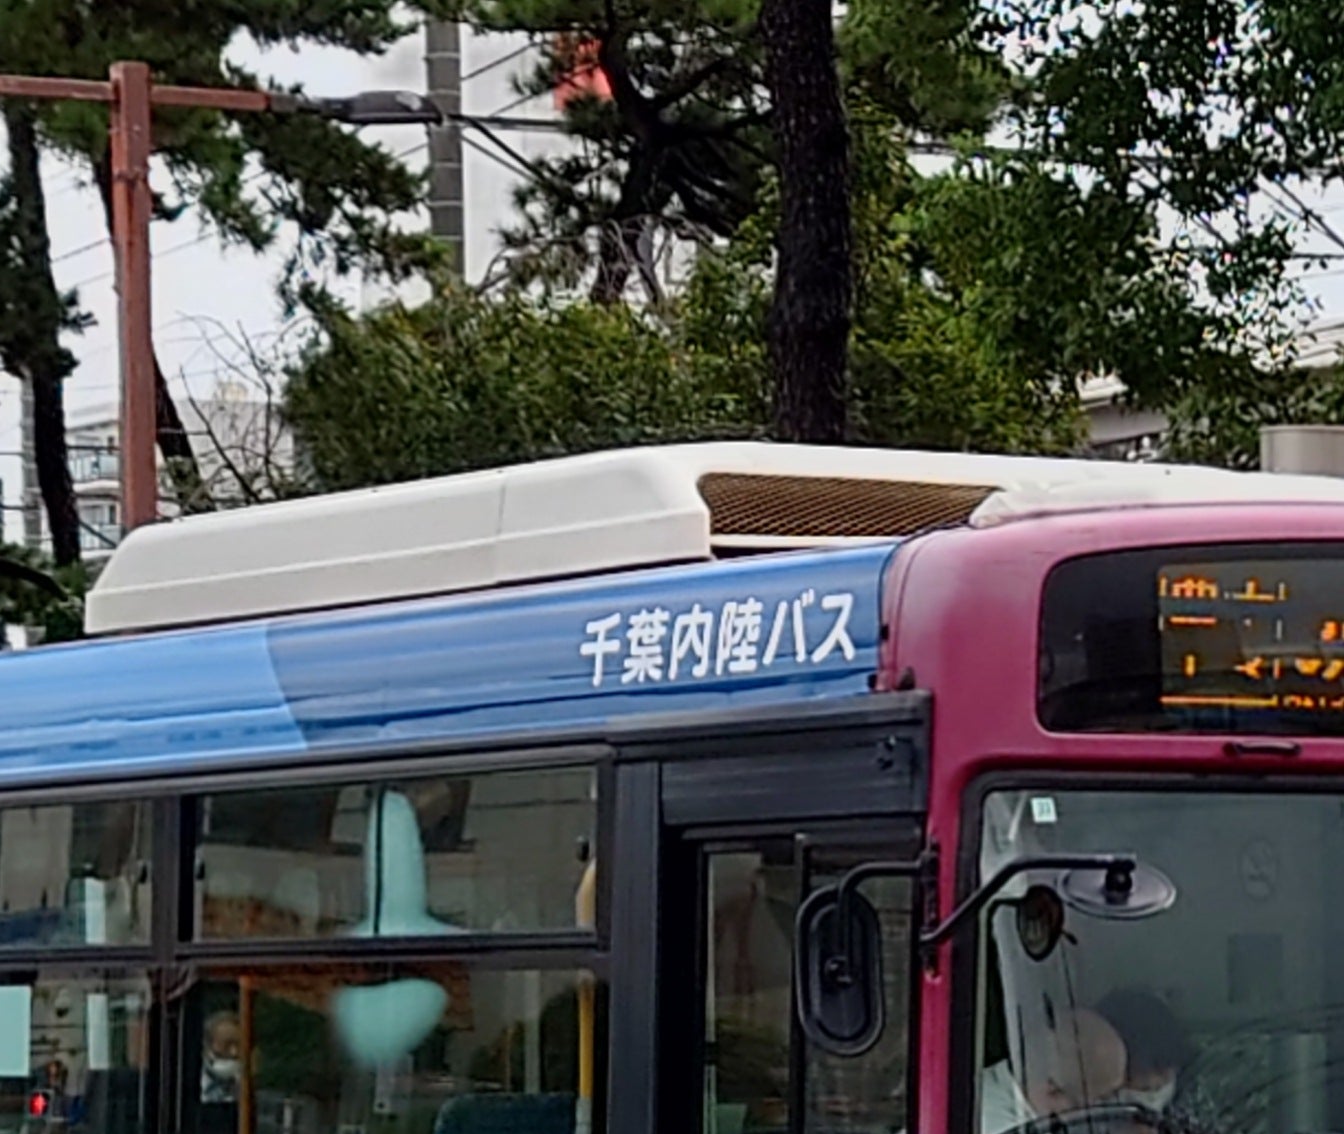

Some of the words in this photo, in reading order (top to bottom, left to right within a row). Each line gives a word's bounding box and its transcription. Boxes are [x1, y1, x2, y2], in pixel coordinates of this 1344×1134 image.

[580, 588, 855, 687] 千葉内陸バス
